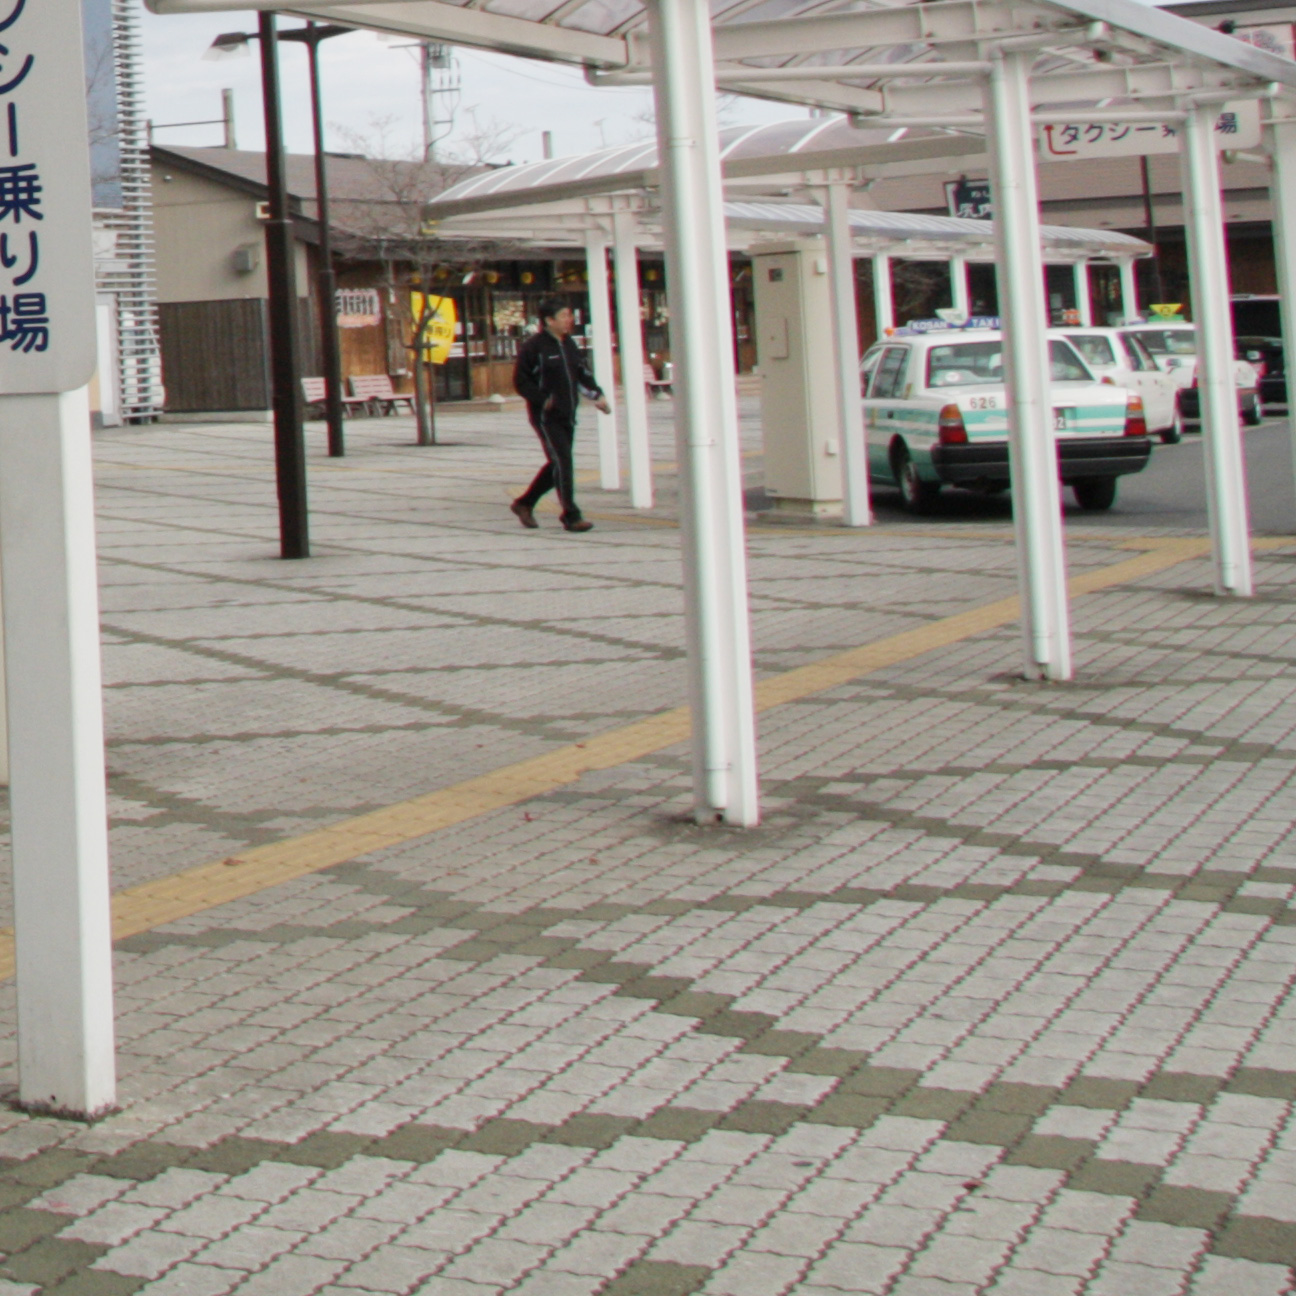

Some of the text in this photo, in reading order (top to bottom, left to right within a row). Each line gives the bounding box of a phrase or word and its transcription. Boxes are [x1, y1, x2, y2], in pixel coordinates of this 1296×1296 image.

[1060, 112, 1237, 145] タクシー場
[969, 396, 996, 410] 626
